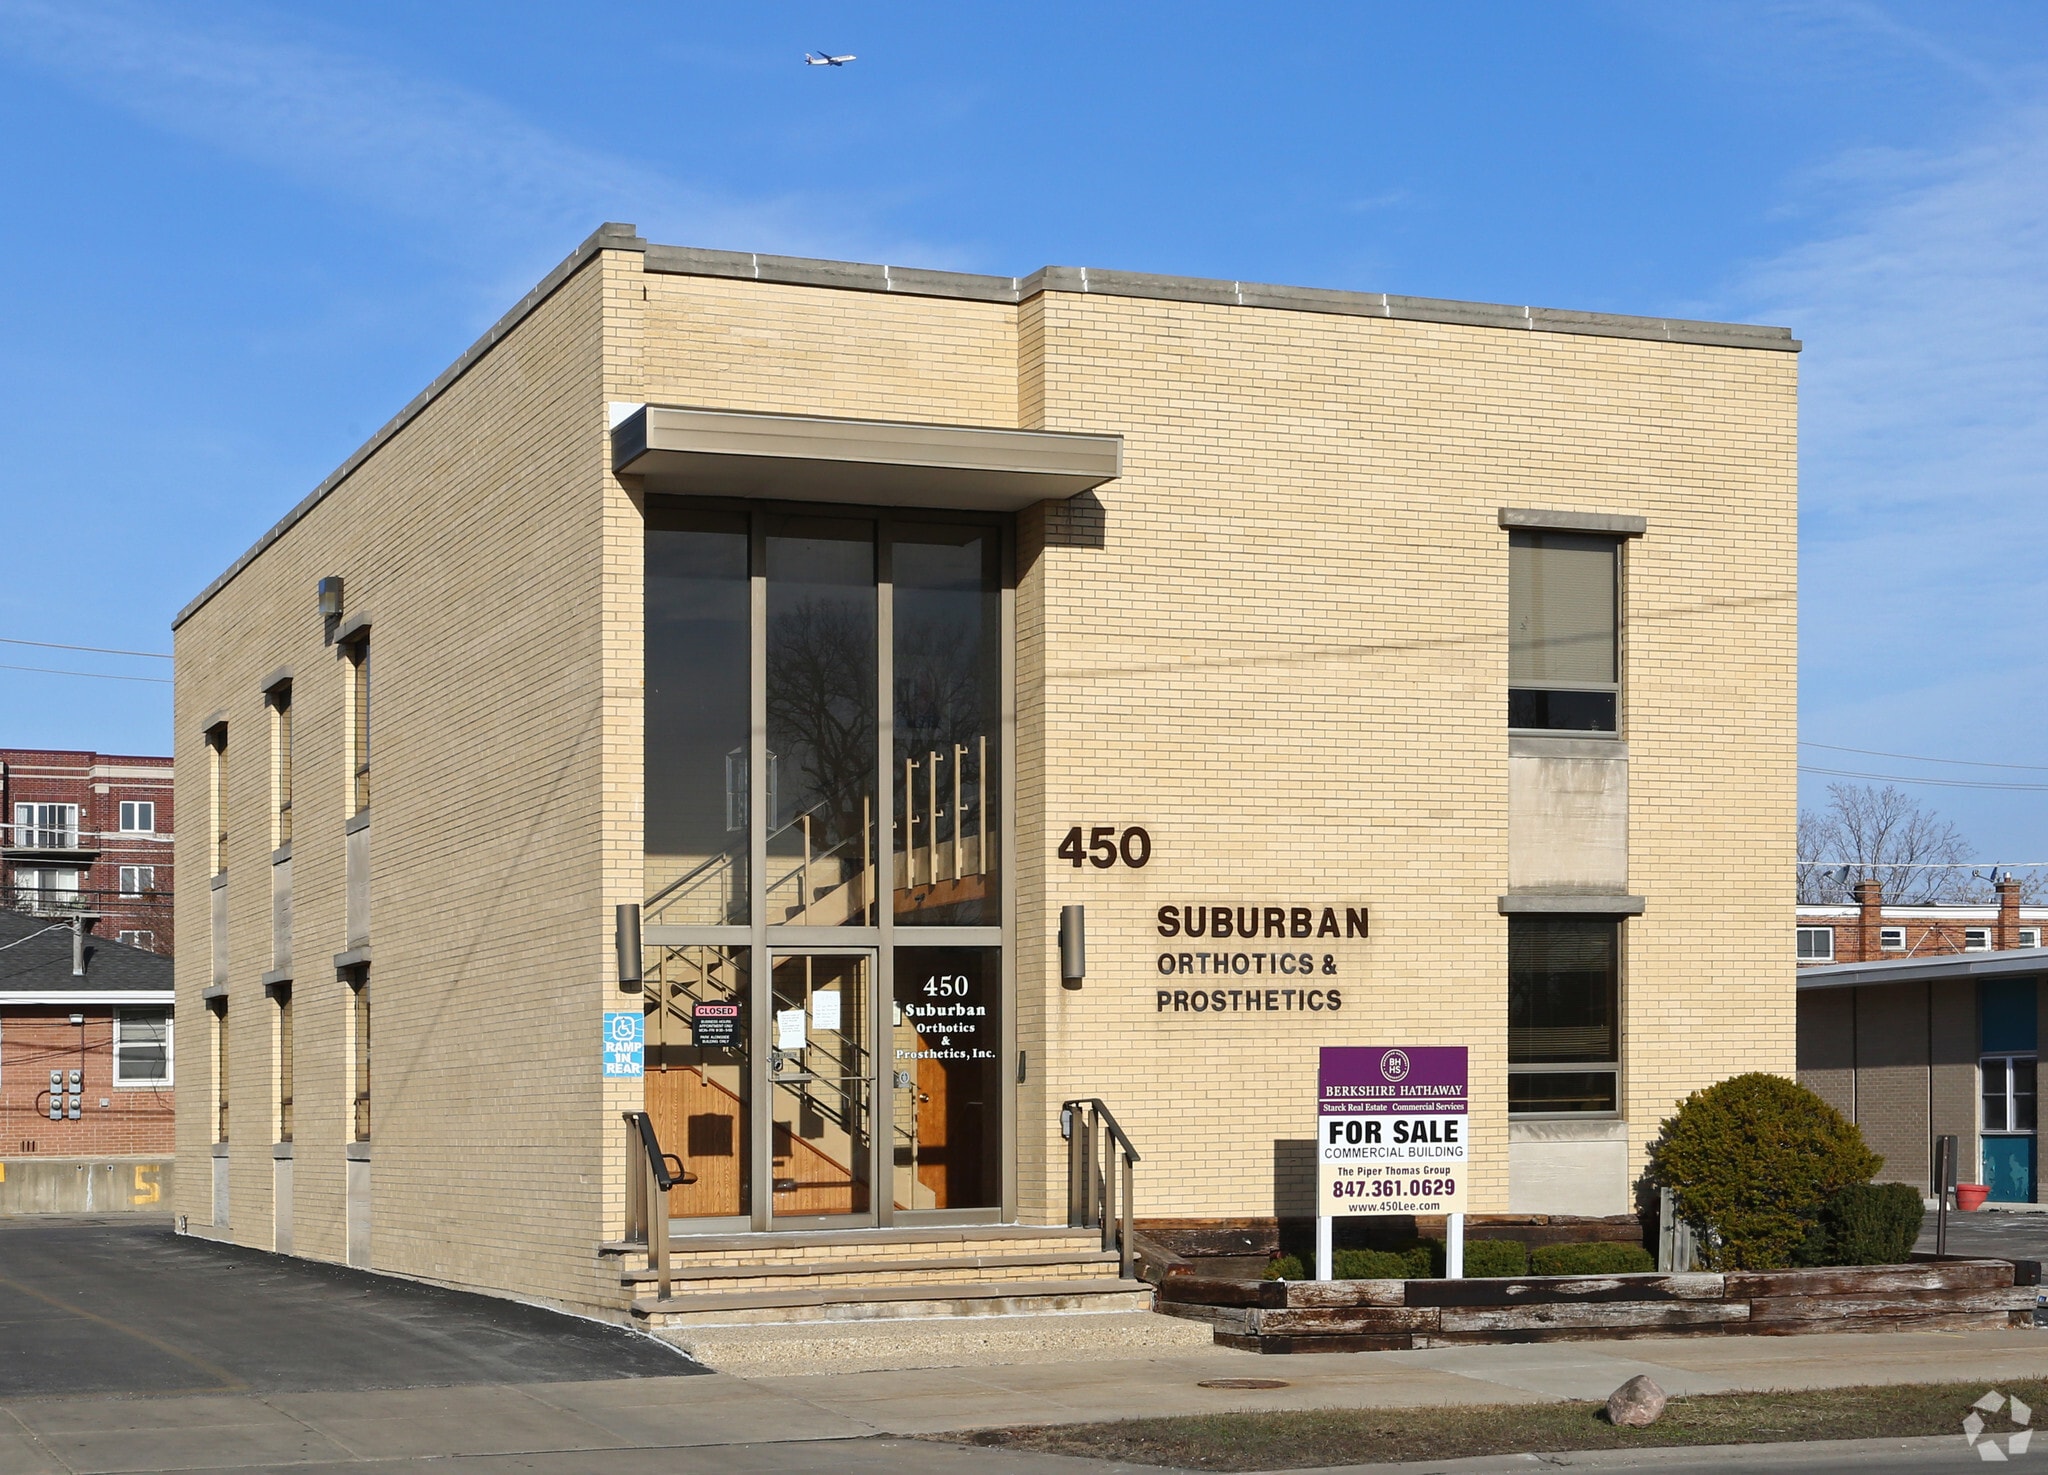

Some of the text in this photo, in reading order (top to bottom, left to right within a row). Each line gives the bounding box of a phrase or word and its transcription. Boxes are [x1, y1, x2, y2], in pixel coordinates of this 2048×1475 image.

[1058, 826, 1151, 869] 450
[1157, 905, 1369, 938] SUBURBAN
[1157, 953, 1337, 975] ORTHOTICS &
[923, 975, 968, 997] 450
[1157, 989, 1342, 1012] PROSTHETICS
[905, 1003, 986, 1017] Suburban
[916, 1022, 975, 1033] Orthotics
[605, 1041, 642, 1052] RAMP
[941, 1035, 950, 1046] &
[614, 1052, 631, 1063] IN
[896, 1048, 996, 1060] Prosthetics, Inc.
[1389, 1057, 1401, 1066] BH
[606, 1063, 641, 1074] REAR
[1389, 1065, 1401, 1074] HS
[1325, 1085, 1463, 1097] BERKSHIRE HATHAWAY
[1323, 1102, 1464, 1112] Starck Real Estate Commercial Services
[1329, 1119, 1458, 1144] FOR SALE
[1324, 1146, 1463, 1159] COMMERCIAL BUILDING
[1338, 1165, 1451, 1178] The Piper Thomas Group
[134, 1164, 161, 1205] 5
[1333, 1179, 1455, 1198] 847.361.0629
[1348, 1201, 1440, 1212] www.450Lee.com
